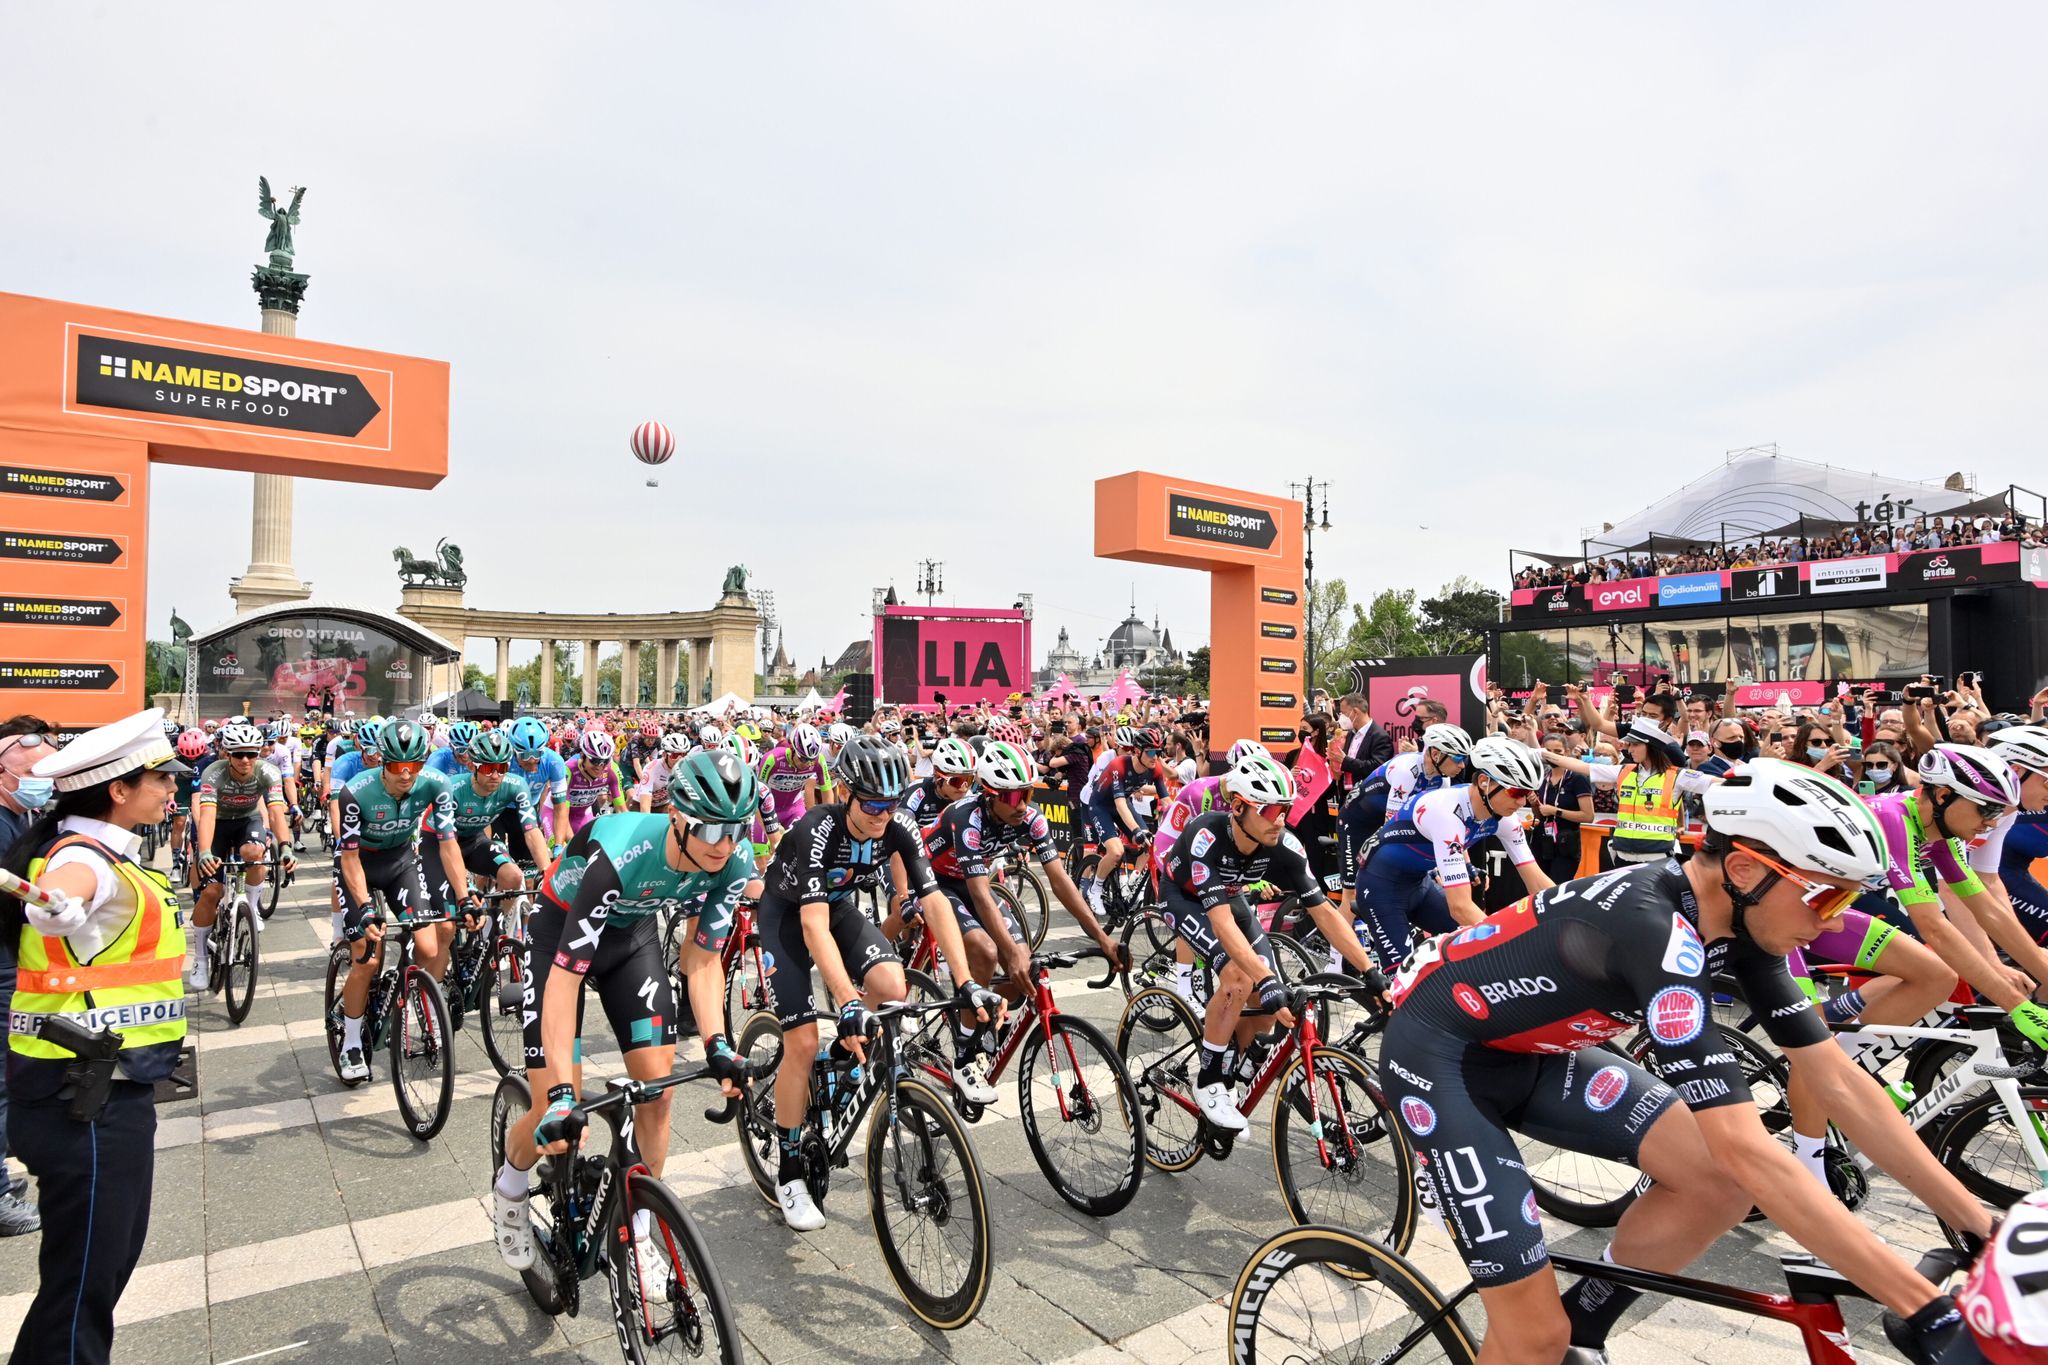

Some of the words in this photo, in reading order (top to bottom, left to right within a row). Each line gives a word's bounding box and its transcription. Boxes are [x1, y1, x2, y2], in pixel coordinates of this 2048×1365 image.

[155, 390, 290, 418] SUPERFOOD
[20, 474, 106, 489] NAMEDSPORT
[29, 485, 85, 495] SUPERFOOD
[1196, 524, 1245, 539] SUPERFOOD
[18, 538, 104, 552] NAMEDSPORT
[27, 549, 83, 558] SUPERFOOD
[1817, 566, 1878, 577] intimissimi
[1834, 576, 1861, 584] UOMO
[1599, 585, 1642, 605] enel
[1661, 583, 1718, 599] mediolanum
[15, 603, 102, 615] NAMEDSPORT
[268, 628, 304, 639] GIRO
[306, 628, 366, 641] D'ITALIA
[14, 668, 100, 678] NAMEDSPORT
[348, 775, 375, 794] BORA
[1790, 778, 1863, 837] SALICE
[612, 840, 654, 872] BORA
[523, 949, 539, 1032] BORA
[1478, 976, 1558, 1005] BRADO
[1657, 991, 1695, 1012] WORK
[1658, 1011, 1691, 1021] GROUP
[1655, 1019, 1695, 1040] SERVICE
[828, 1063, 878, 1155] SCOTT
[1430, 1148, 1452, 1195] DRONE
[1448, 1196, 1473, 1250] HOPPER
